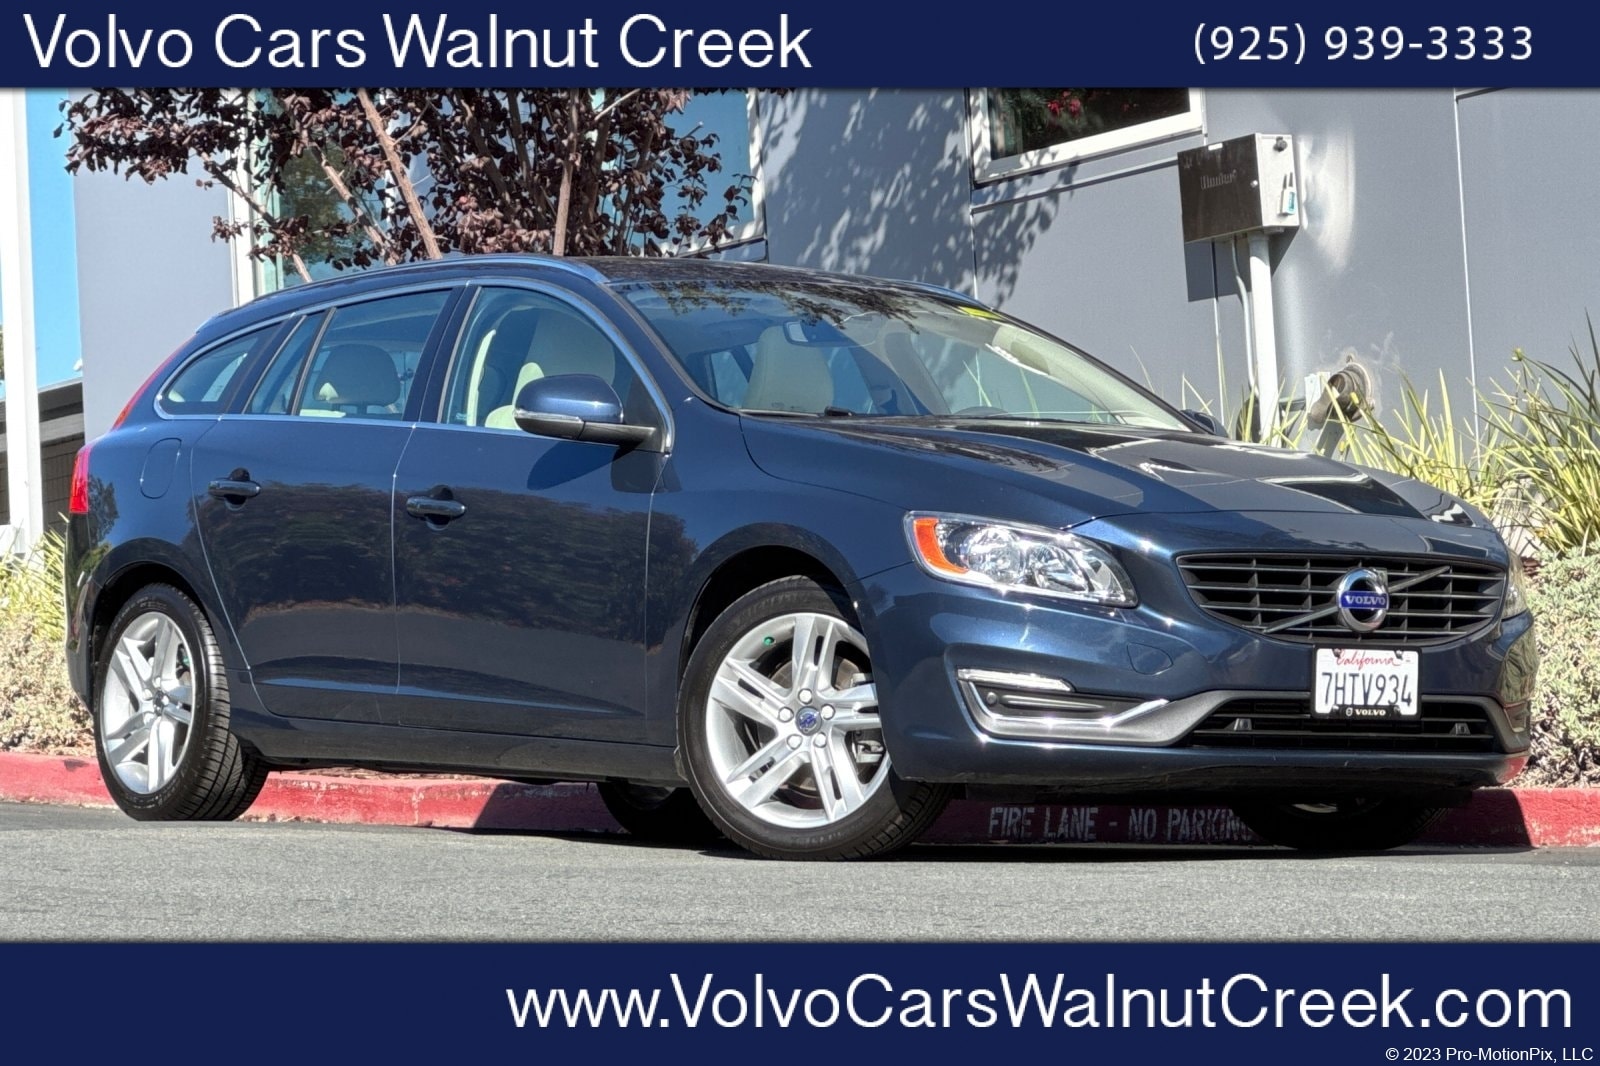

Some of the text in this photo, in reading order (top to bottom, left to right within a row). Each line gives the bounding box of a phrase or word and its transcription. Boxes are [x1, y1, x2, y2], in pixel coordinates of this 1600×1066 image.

[1345, 595, 1386, 606] VOLVO
[1335, 648, 1401, 670] California
[1322, 672, 1412, 707] 7HTV934
[1355, 708, 1386, 716] VOLVO
[989, 806, 1035, 839] FIRE
[1043, 806, 1099, 840] LANE
[1128, 808, 1157, 841] NO
